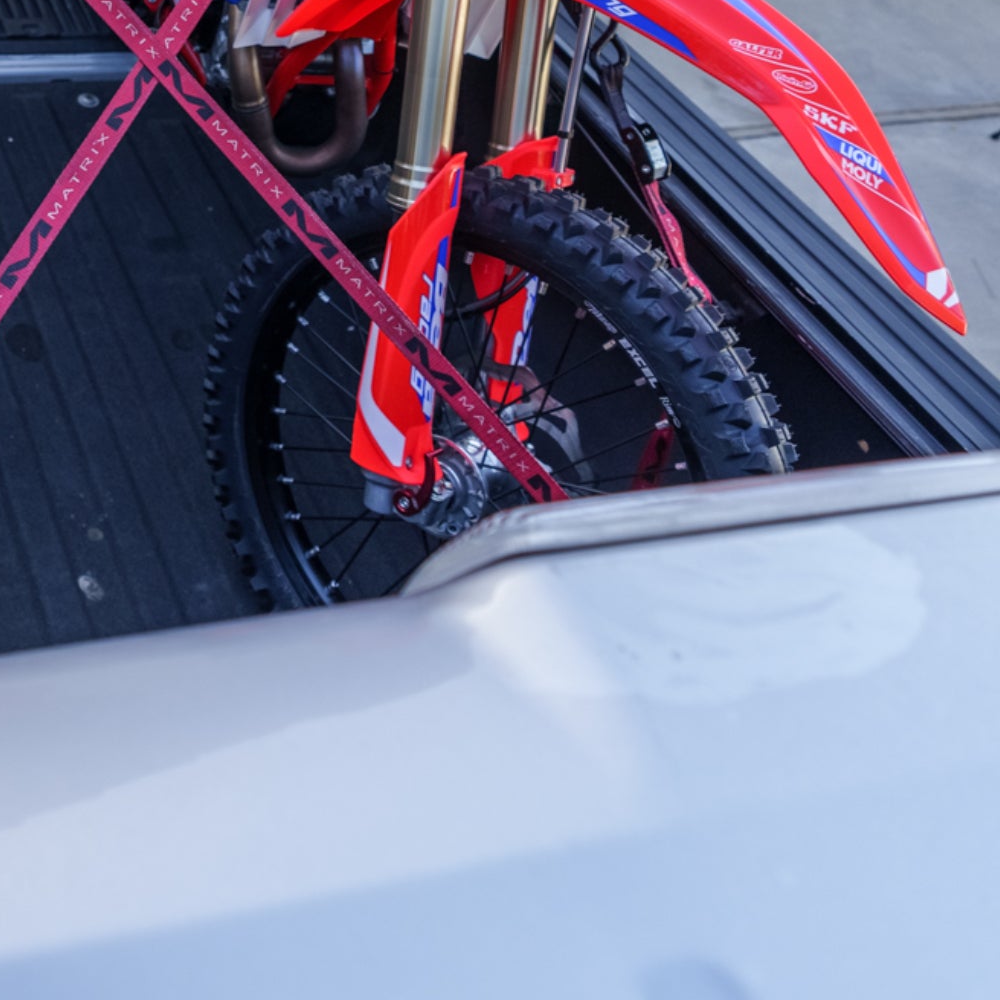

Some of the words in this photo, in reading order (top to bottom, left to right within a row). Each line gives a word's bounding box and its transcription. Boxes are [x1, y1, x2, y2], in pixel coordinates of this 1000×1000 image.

[803, 104, 858, 134] SKF
[47, 132, 109, 220] MATRIX
[212, 119, 283, 199] MATRIX
[840, 142, 883, 175] LIQUI
[841, 157, 884, 189] MOLY
[336, 257, 407, 336] MATRIX
[458, 396, 529, 473] MATRIX
